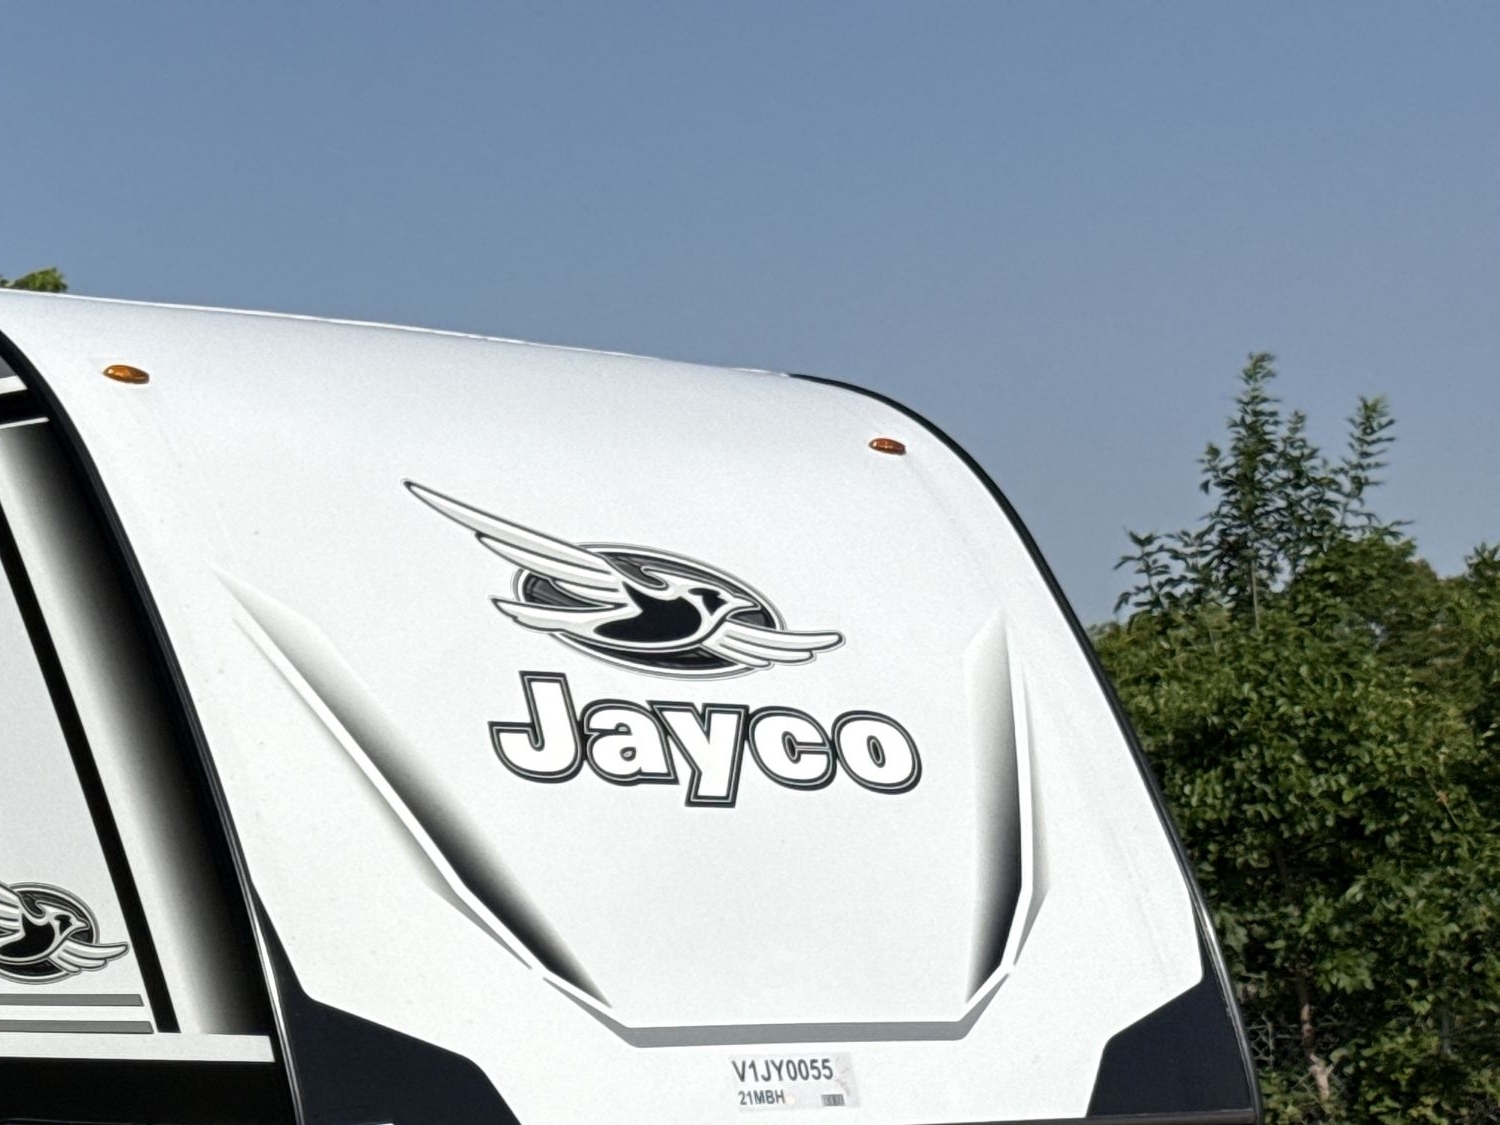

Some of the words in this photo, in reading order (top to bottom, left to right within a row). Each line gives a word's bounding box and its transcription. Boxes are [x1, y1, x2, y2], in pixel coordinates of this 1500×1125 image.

[487, 670, 923, 808] Jayco
[731, 1057, 834, 1083] V1JY0055
[737, 1089, 786, 1106] 21MBH
